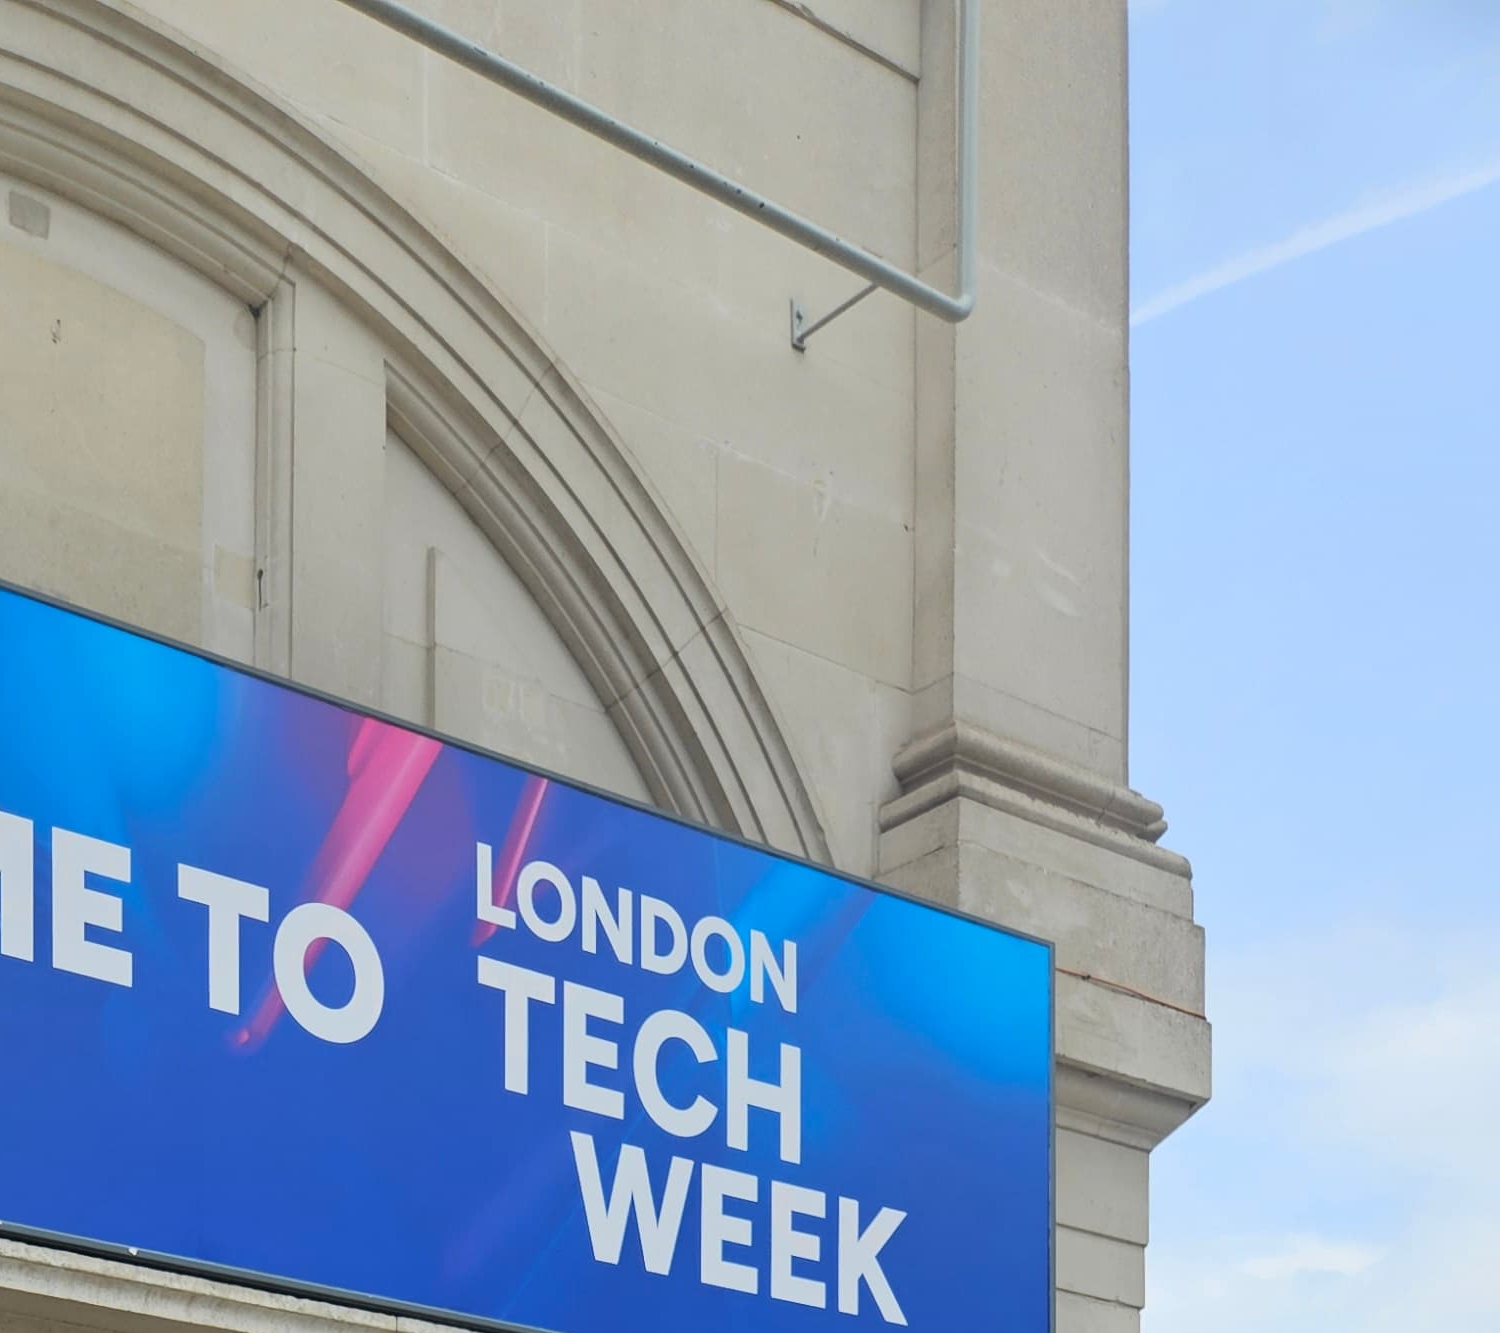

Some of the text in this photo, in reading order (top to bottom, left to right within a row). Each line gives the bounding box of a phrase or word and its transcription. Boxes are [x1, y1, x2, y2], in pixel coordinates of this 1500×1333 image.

[178, 862, 386, 1044] TO
[476, 842, 797, 1013] LONDON
[478, 956, 802, 1164] TECH
[570, 1131, 909, 1327] WEEK
